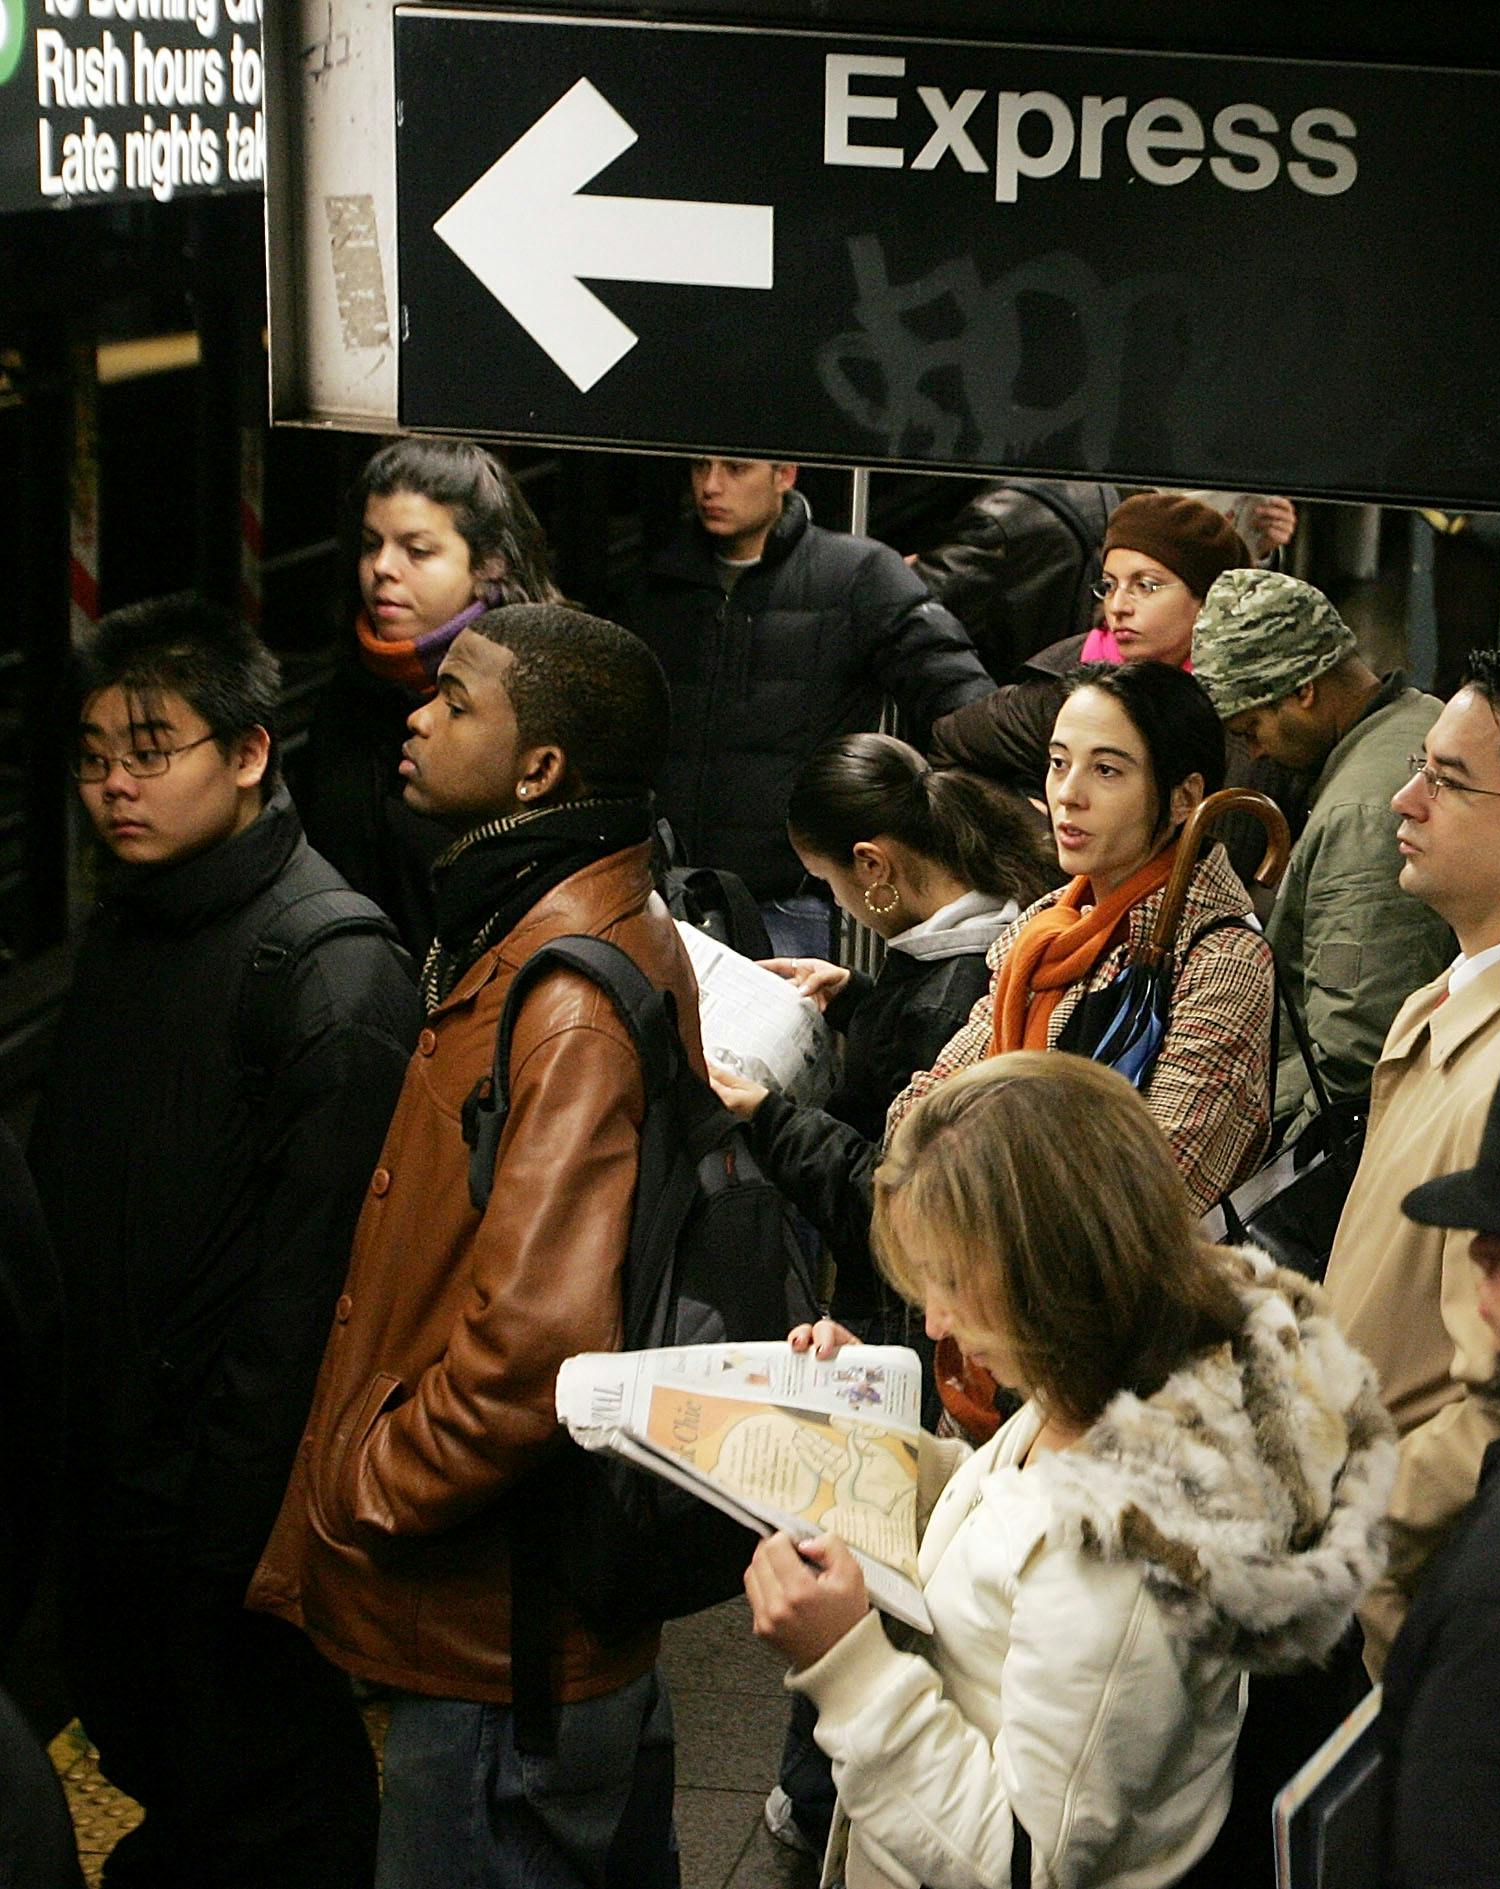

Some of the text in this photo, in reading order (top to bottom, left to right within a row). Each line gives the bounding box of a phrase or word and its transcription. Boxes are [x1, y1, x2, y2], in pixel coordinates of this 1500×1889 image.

[36, 28, 262, 107] Rush hours to
[38, 116, 120, 195] Late
[125, 113, 221, 202] nights
[823, 53, 1358, 203] Express
